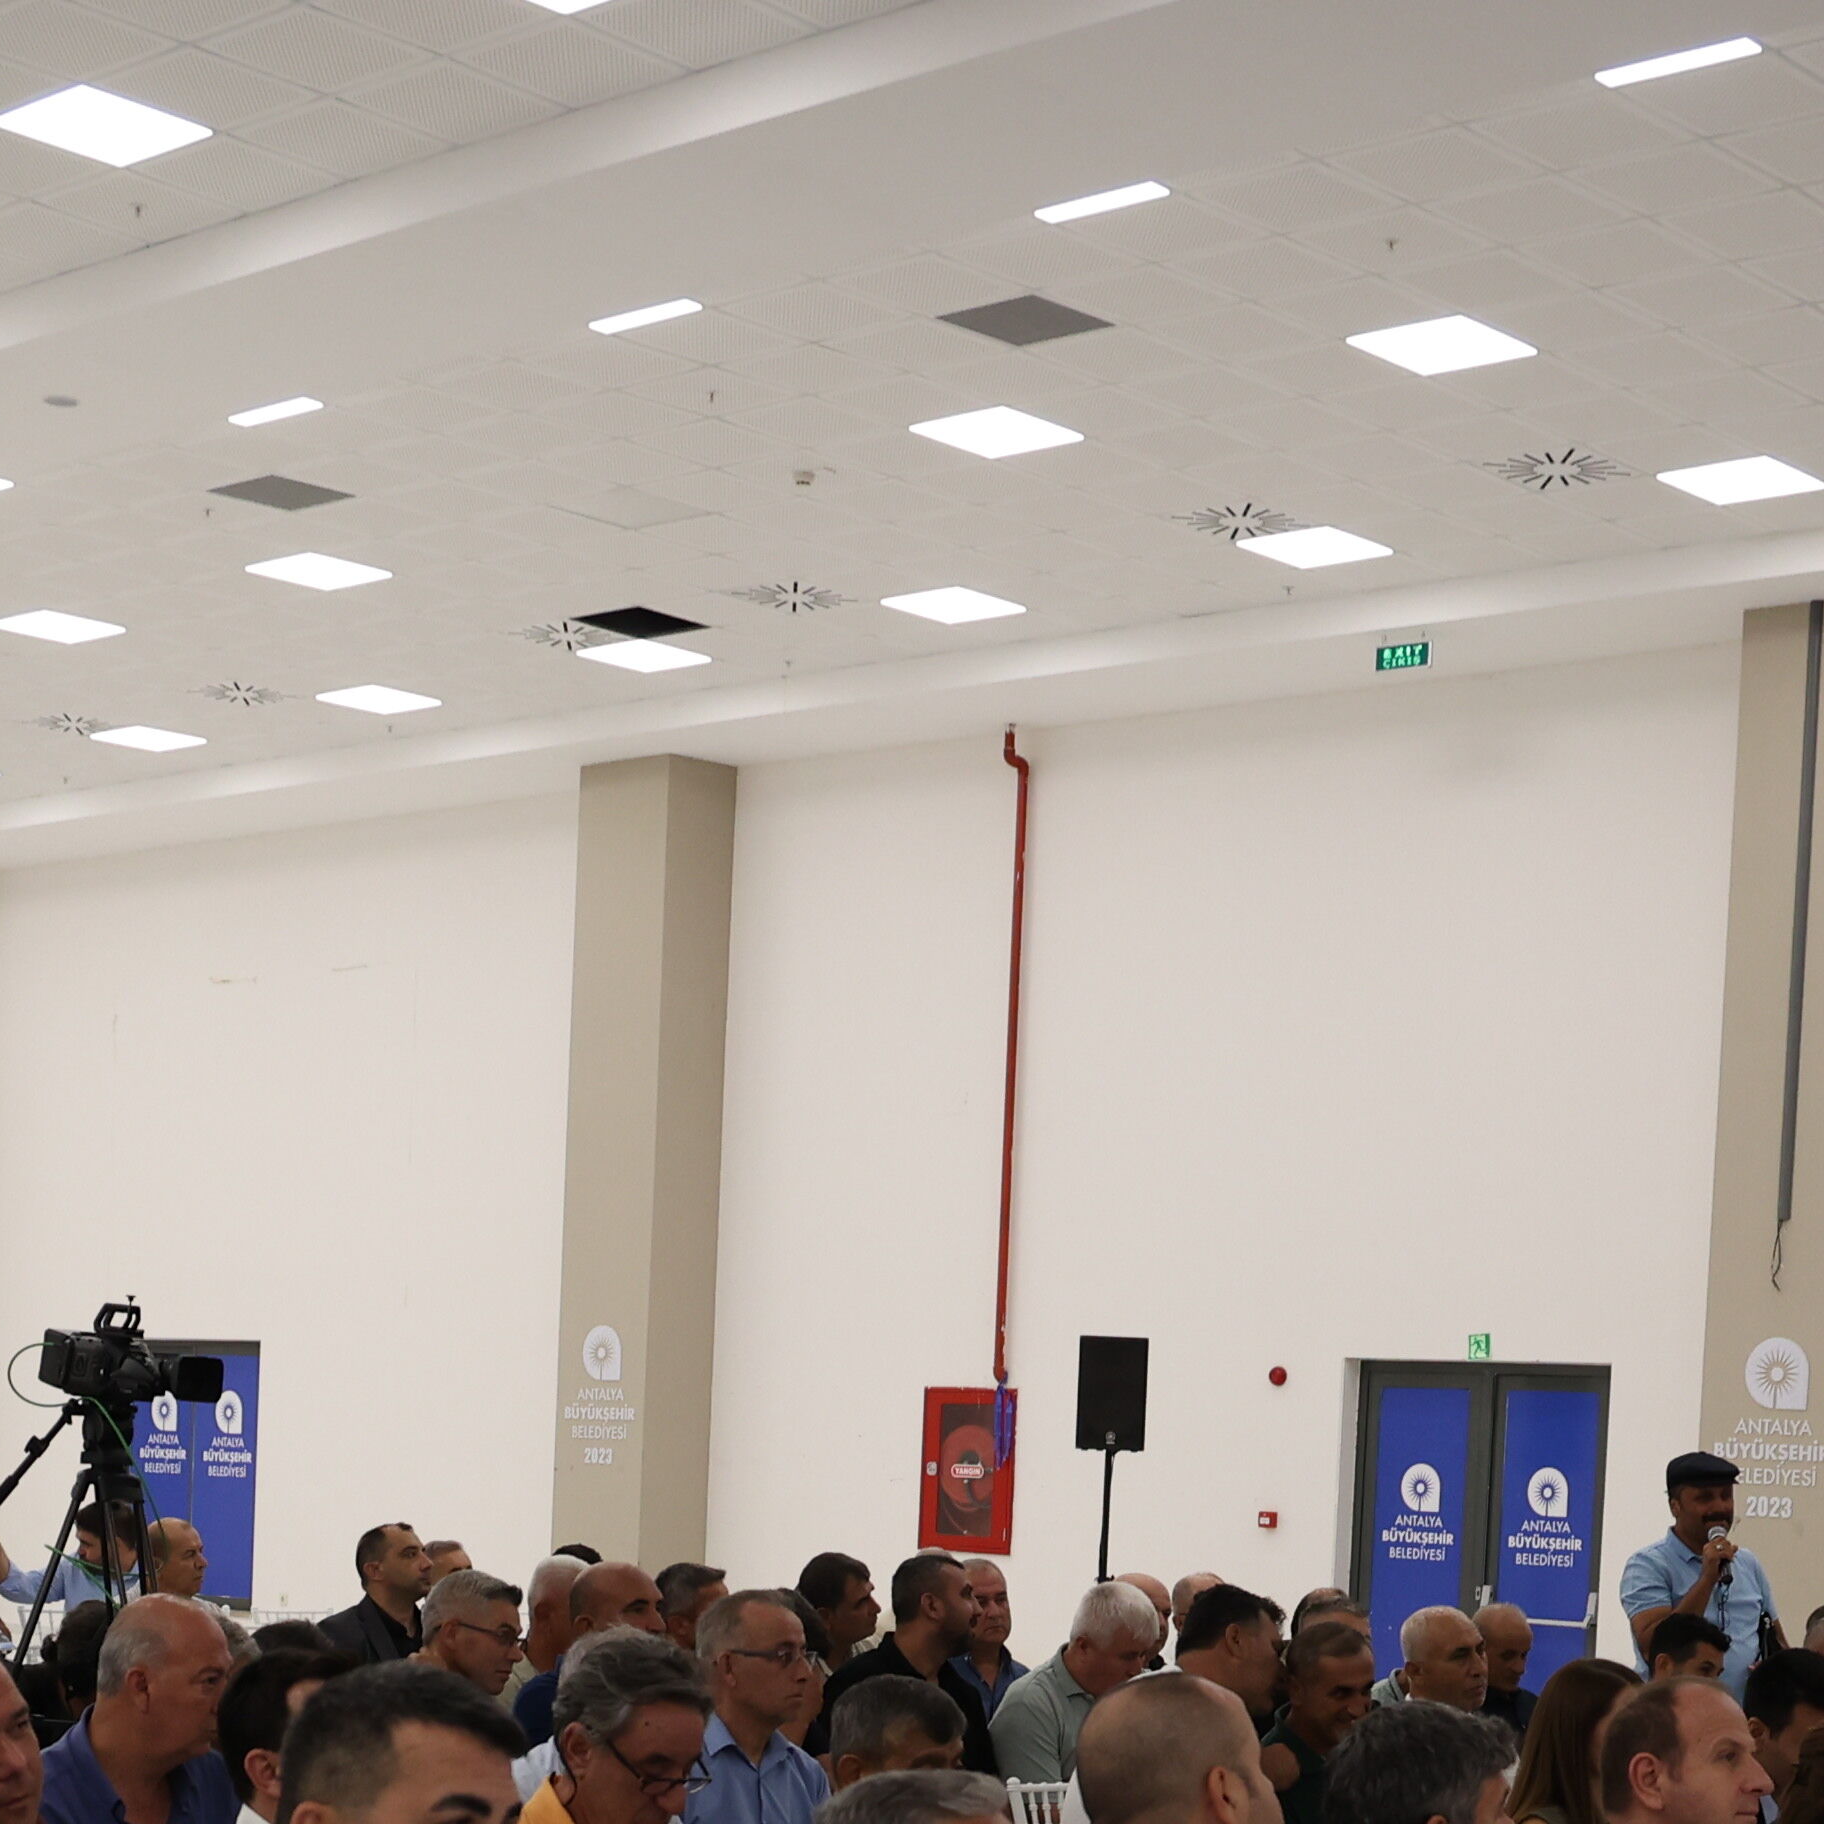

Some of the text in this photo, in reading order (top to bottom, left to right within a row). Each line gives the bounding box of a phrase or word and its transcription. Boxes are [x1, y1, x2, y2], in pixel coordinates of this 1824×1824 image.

[577, 1387, 624, 1401] ANTALYA
[564, 1403, 635, 1422] BÜYÜKŞEHİR
[571, 1423, 627, 1440] BELEDİYESİ
[1734, 1417, 1813, 1436] ANTALYA
[148, 1433, 179, 1445] ANTALYA
[212, 1436, 245, 1448] ANTALYA
[139, 1445, 186, 1460] BÜYÜKŞEHİR
[203, 1449, 252, 1464] BÜYÜKŞEHİR
[584, 1447, 613, 1464] 2023
[144, 1461, 181, 1474] BELEDİYESİ
[208, 1464, 247, 1477] BELEDİYESİ
[1736, 1463, 1817, 1488] ELEDİYESİ
[1745, 1495, 1793, 1518] 2023
[1394, 1514, 1443, 1528] ANTALYA
[1521, 1519, 1571, 1533] ANTALYA
[1382, 1527, 1454, 1546] BÜYÜKŞEHİR
[1508, 1533, 1582, 1552] BÜYÜKŞEHİR
[1389, 1546, 1445, 1561] BELEDİYESİ
[1515, 1551, 1574, 1568] BELEDİYESİ
